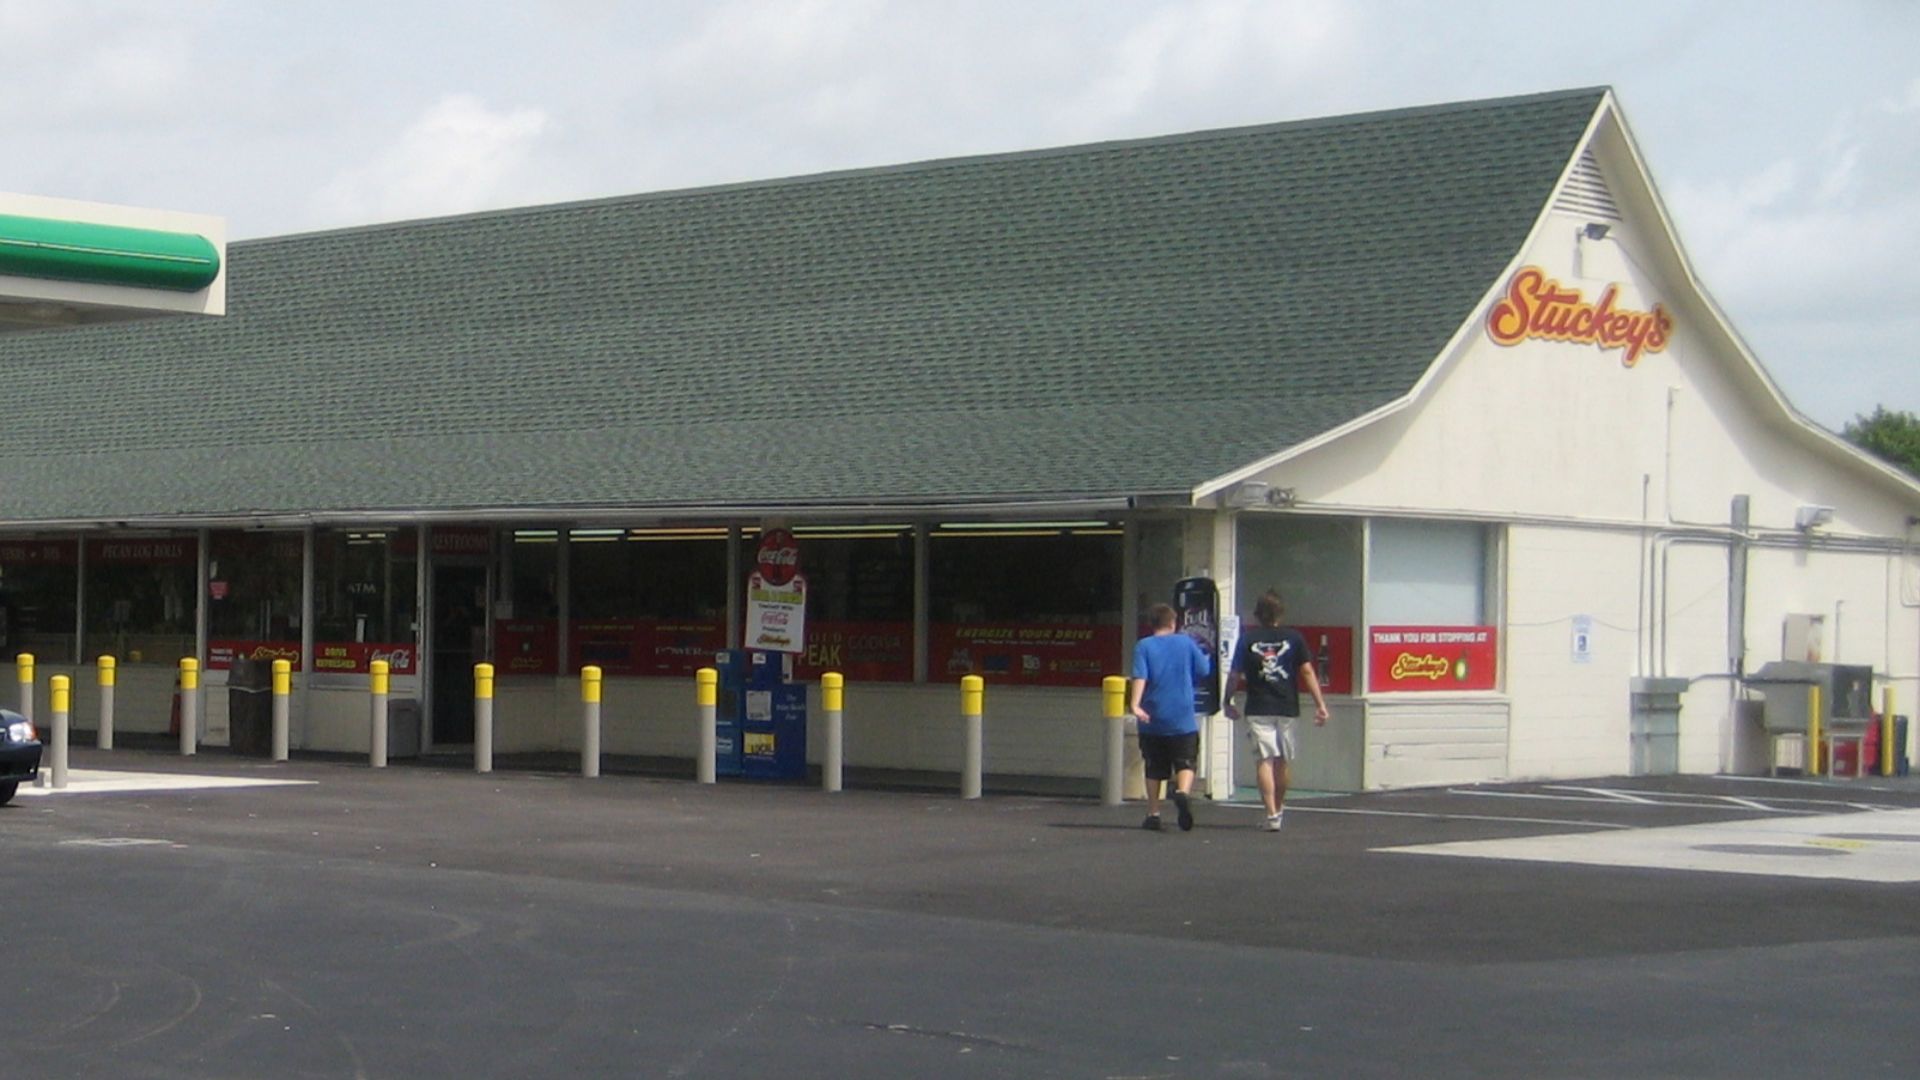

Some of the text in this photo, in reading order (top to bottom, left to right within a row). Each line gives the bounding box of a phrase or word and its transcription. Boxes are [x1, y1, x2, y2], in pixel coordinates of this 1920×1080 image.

[1487, 265, 1673, 367] Stuckey's
[347, 582, 377, 594] ATM
[1017, 629, 1051, 639] YOUR
[1053, 630, 1094, 641] DRIVE
[1373, 632, 1488, 643] THANK YOU FOR STOPPING AT
